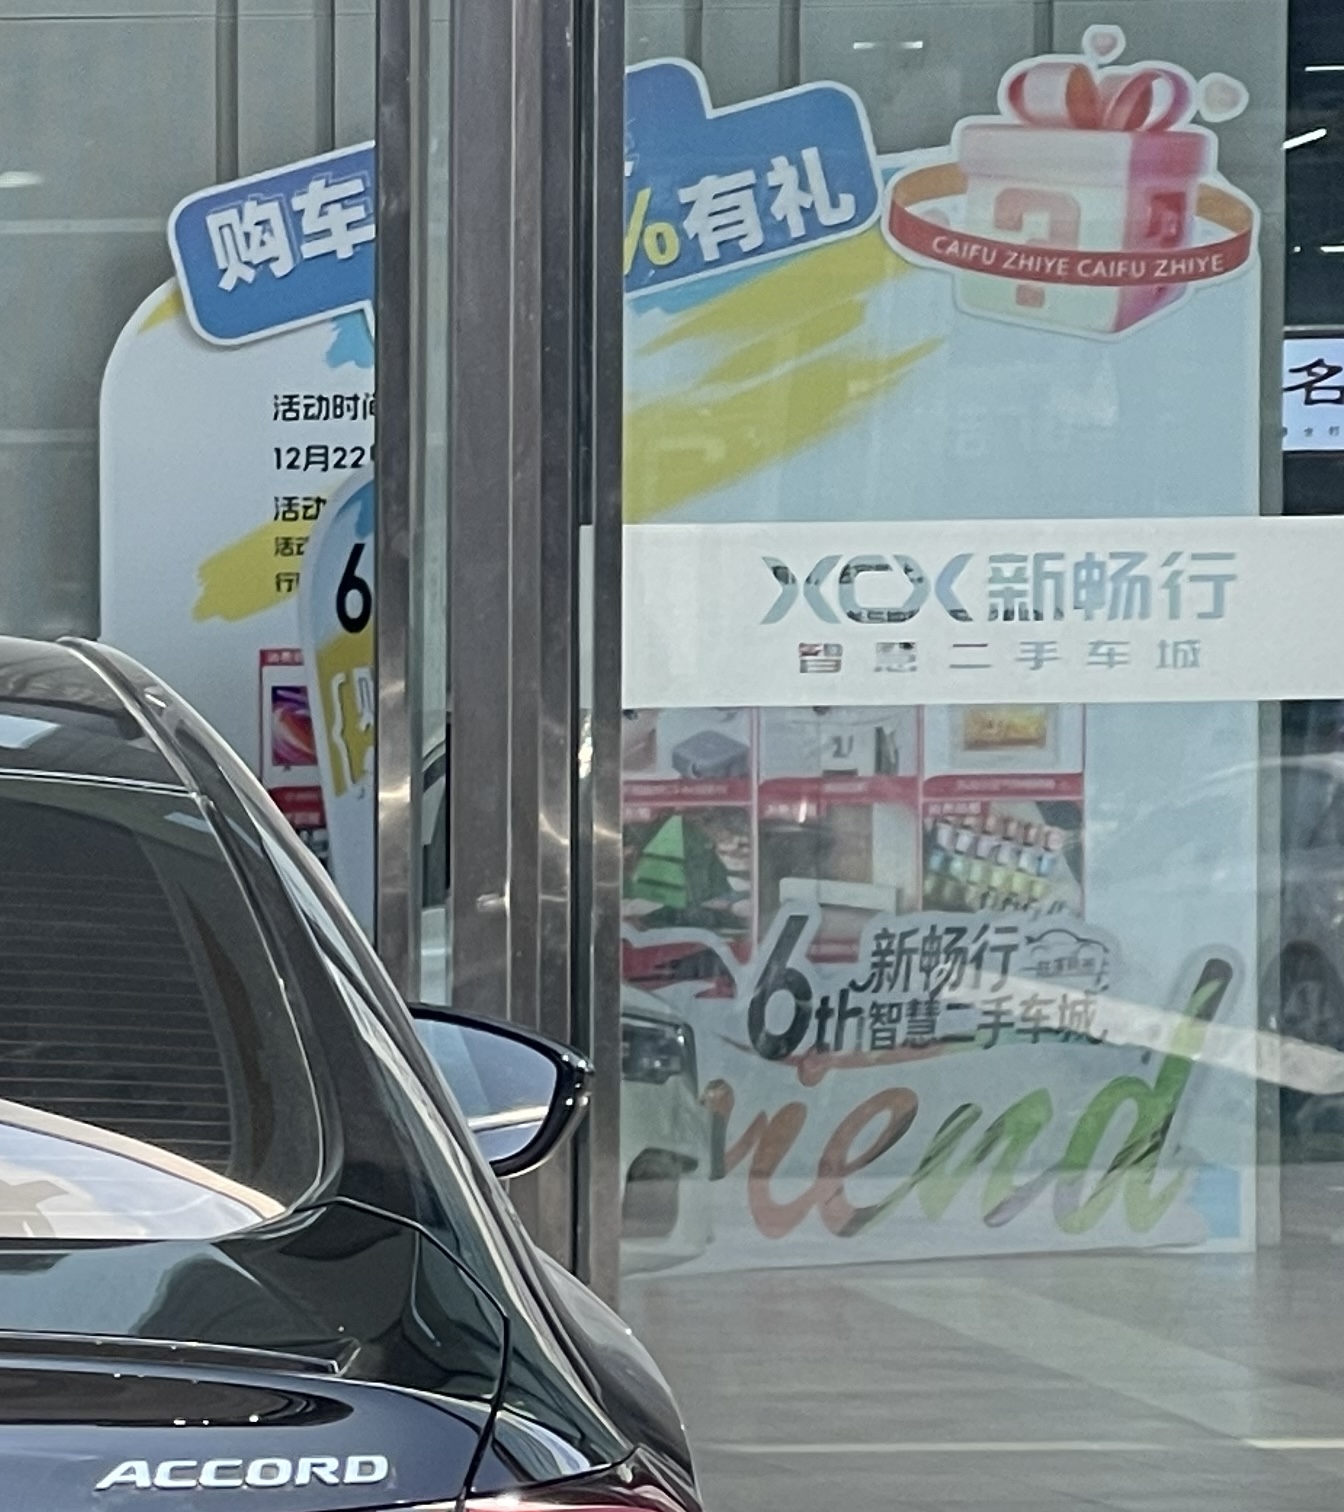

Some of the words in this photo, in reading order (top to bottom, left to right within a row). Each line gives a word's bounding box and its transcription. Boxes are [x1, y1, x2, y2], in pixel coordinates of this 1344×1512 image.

[206, 178, 376, 292] 购车
[932, 236, 996, 265] CAIFU
[1003, 251, 1068, 276] ZHIYE
[1077, 259, 1146, 278] CAIFU
[1155, 254, 1224, 277] ZHIYE
[273, 445, 376, 472] 12月22
[988, 551, 1237, 621] 新畅行
[798, 638, 1202, 674] 智慧二手车城
[852, 923, 1019, 994] 新畅行
[869, 988, 1108, 1050] 智慧二手车城
[94, 1455, 390, 1491] ACCORD
